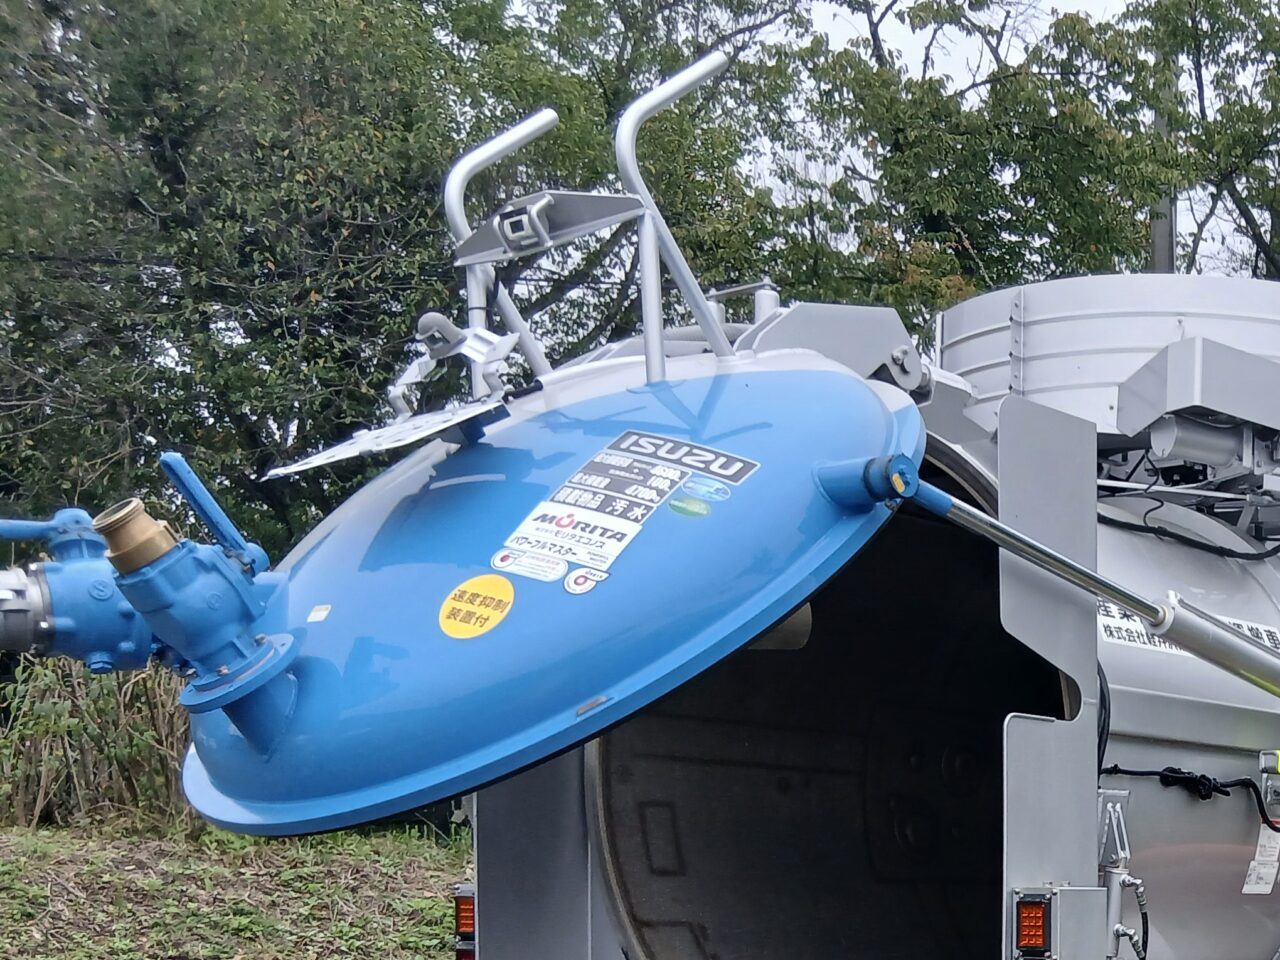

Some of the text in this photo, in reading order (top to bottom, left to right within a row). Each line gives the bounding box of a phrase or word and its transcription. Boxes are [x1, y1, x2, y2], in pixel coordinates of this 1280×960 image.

[620, 435, 744, 476] ISUZU
[532, 513, 628, 543] MORITA
[450, 589, 511, 613] 速度抑制
[445, 607, 490, 628] 装置付
